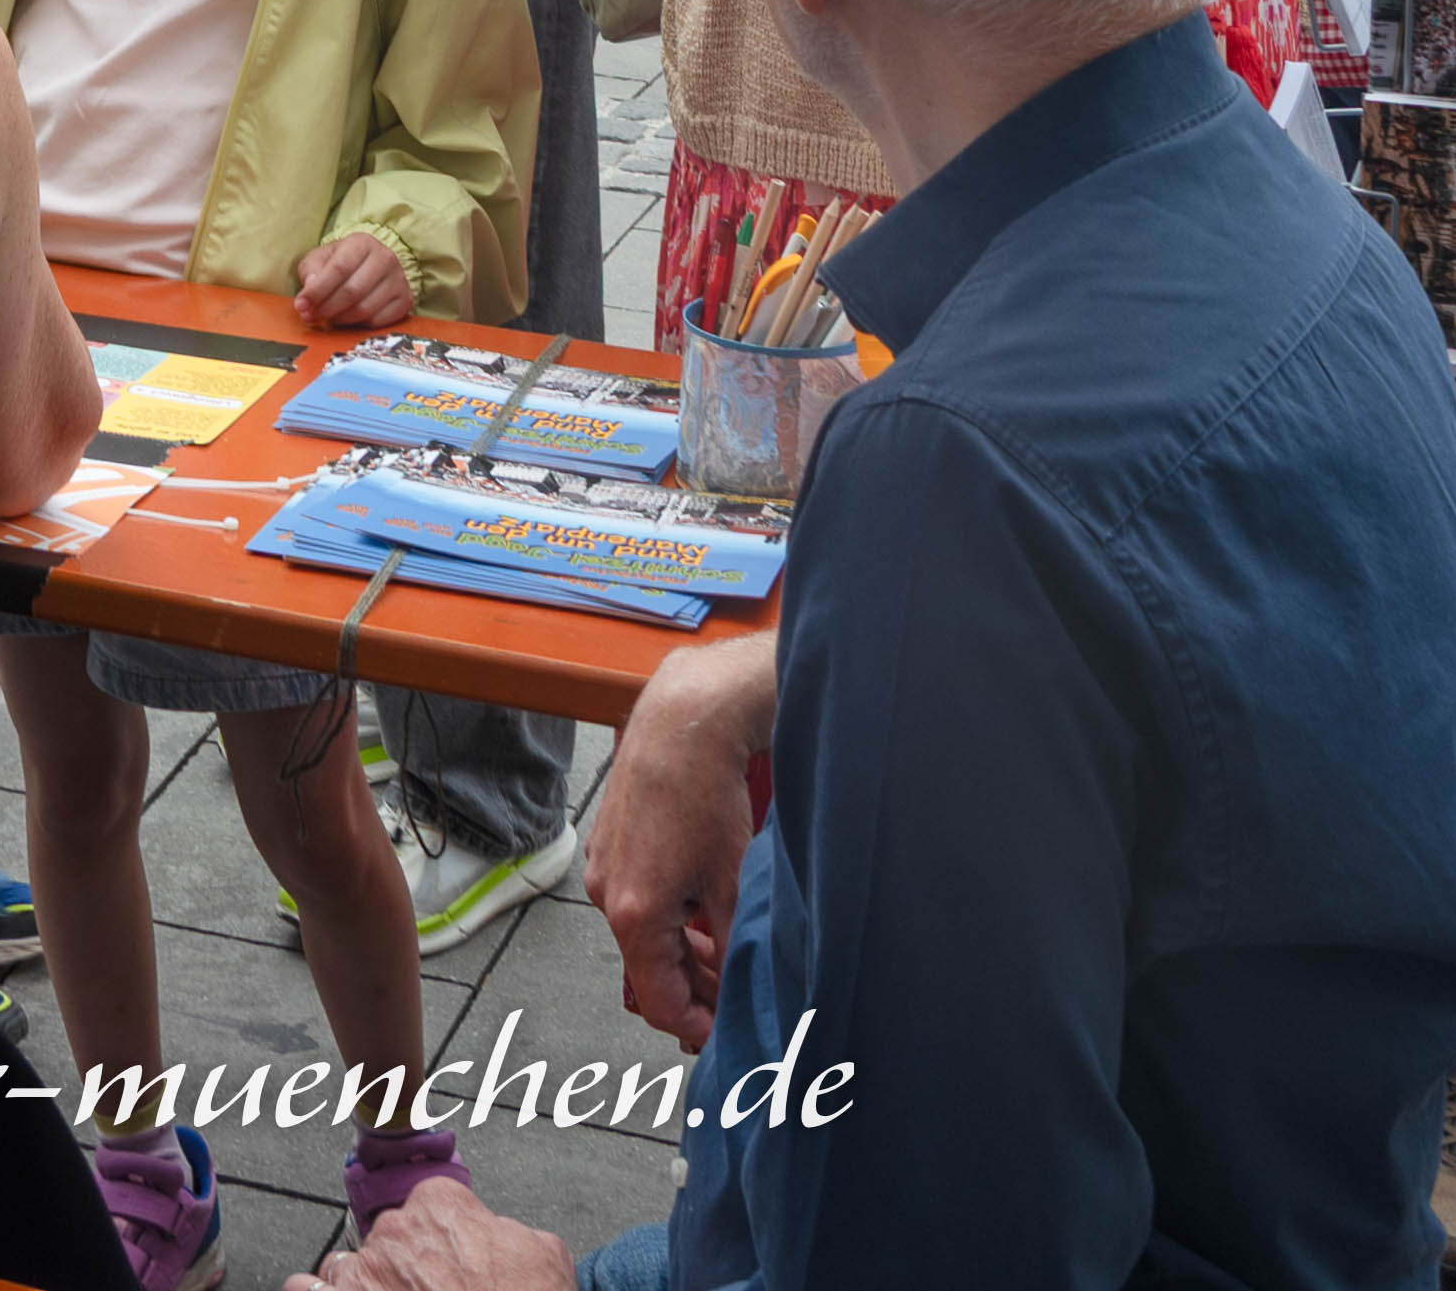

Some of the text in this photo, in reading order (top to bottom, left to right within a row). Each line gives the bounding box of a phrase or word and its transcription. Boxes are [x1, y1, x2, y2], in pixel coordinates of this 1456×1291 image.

[531, 416, 613, 440] Rund
[464, 518, 527, 542] den
[497, 515, 708, 556] Marienplatz
[545, 532, 596, 552] um
[614, 544, 702, 567] Rund
